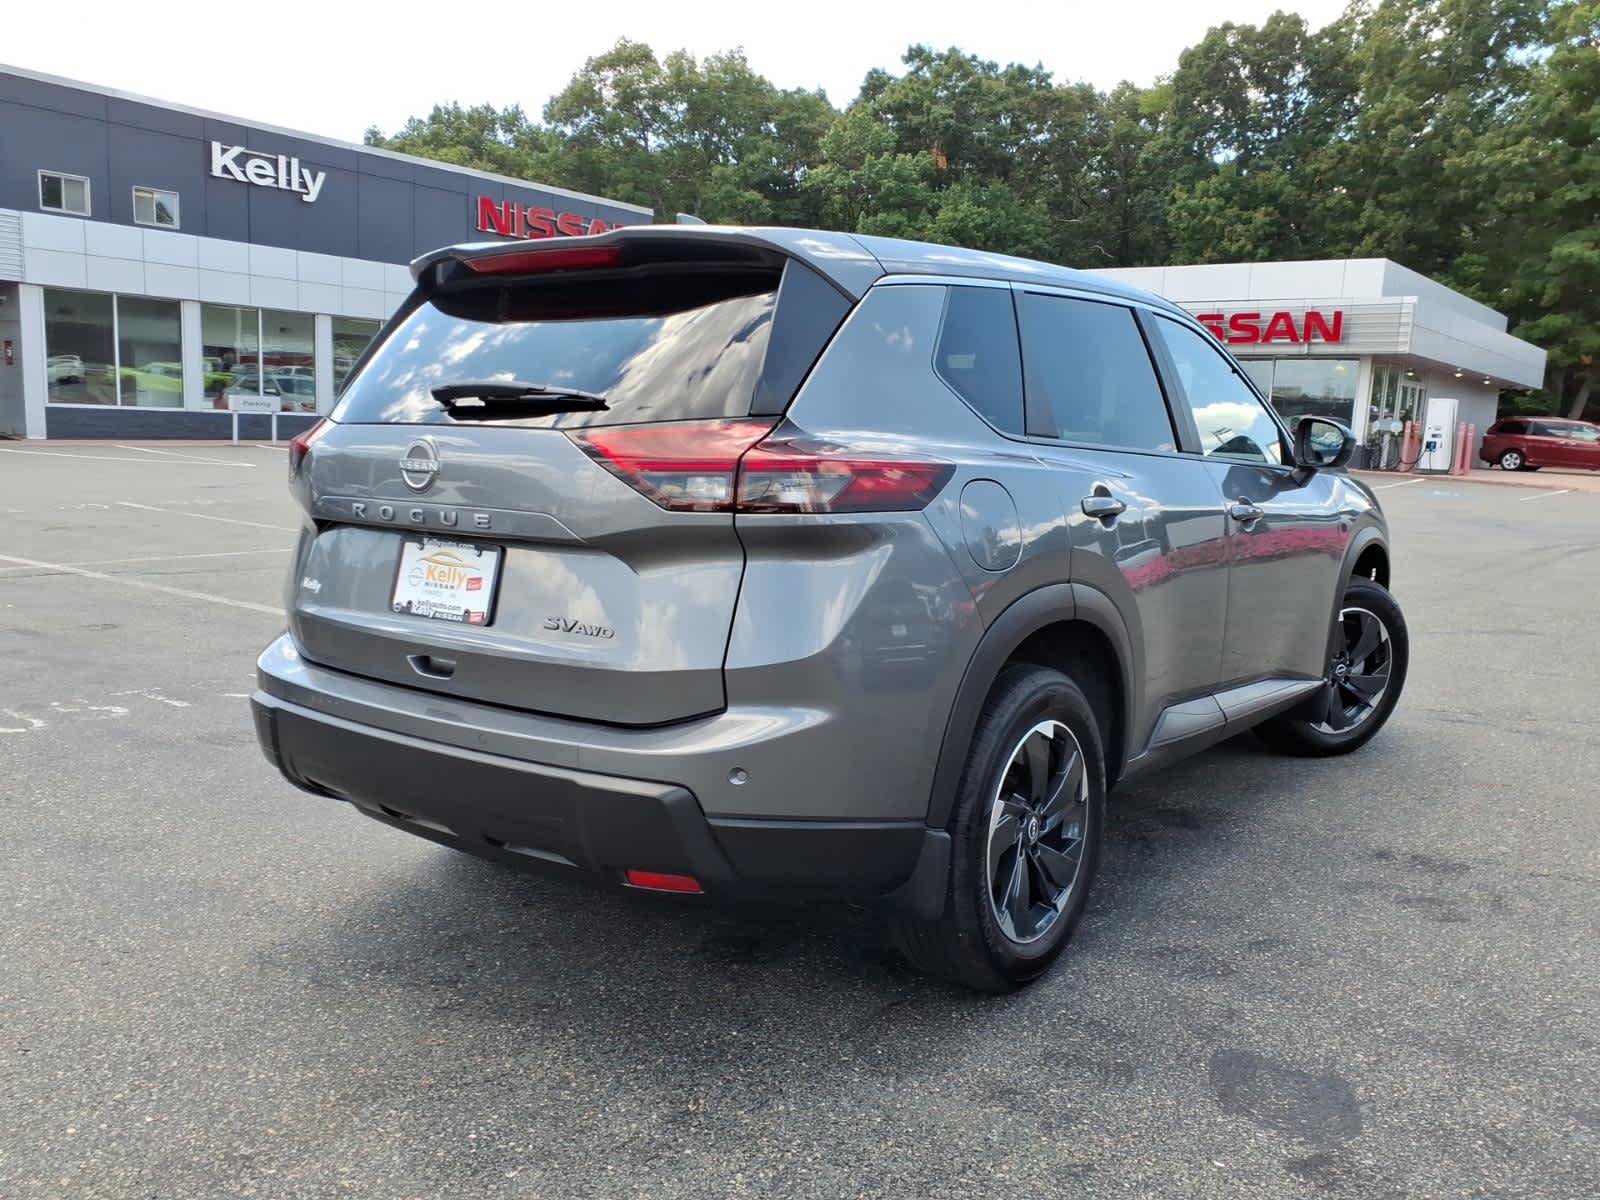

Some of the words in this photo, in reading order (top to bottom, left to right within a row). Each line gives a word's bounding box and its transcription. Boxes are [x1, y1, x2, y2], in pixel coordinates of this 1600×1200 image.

[211, 141, 326, 202] Kelly
[477, 195, 623, 239] NISSA
[400, 460, 439, 471] NISSAN
[352, 503, 492, 529] ROGUE
[425, 582, 456, 590] NISSAN
[427, 565, 465, 591] Kelly
